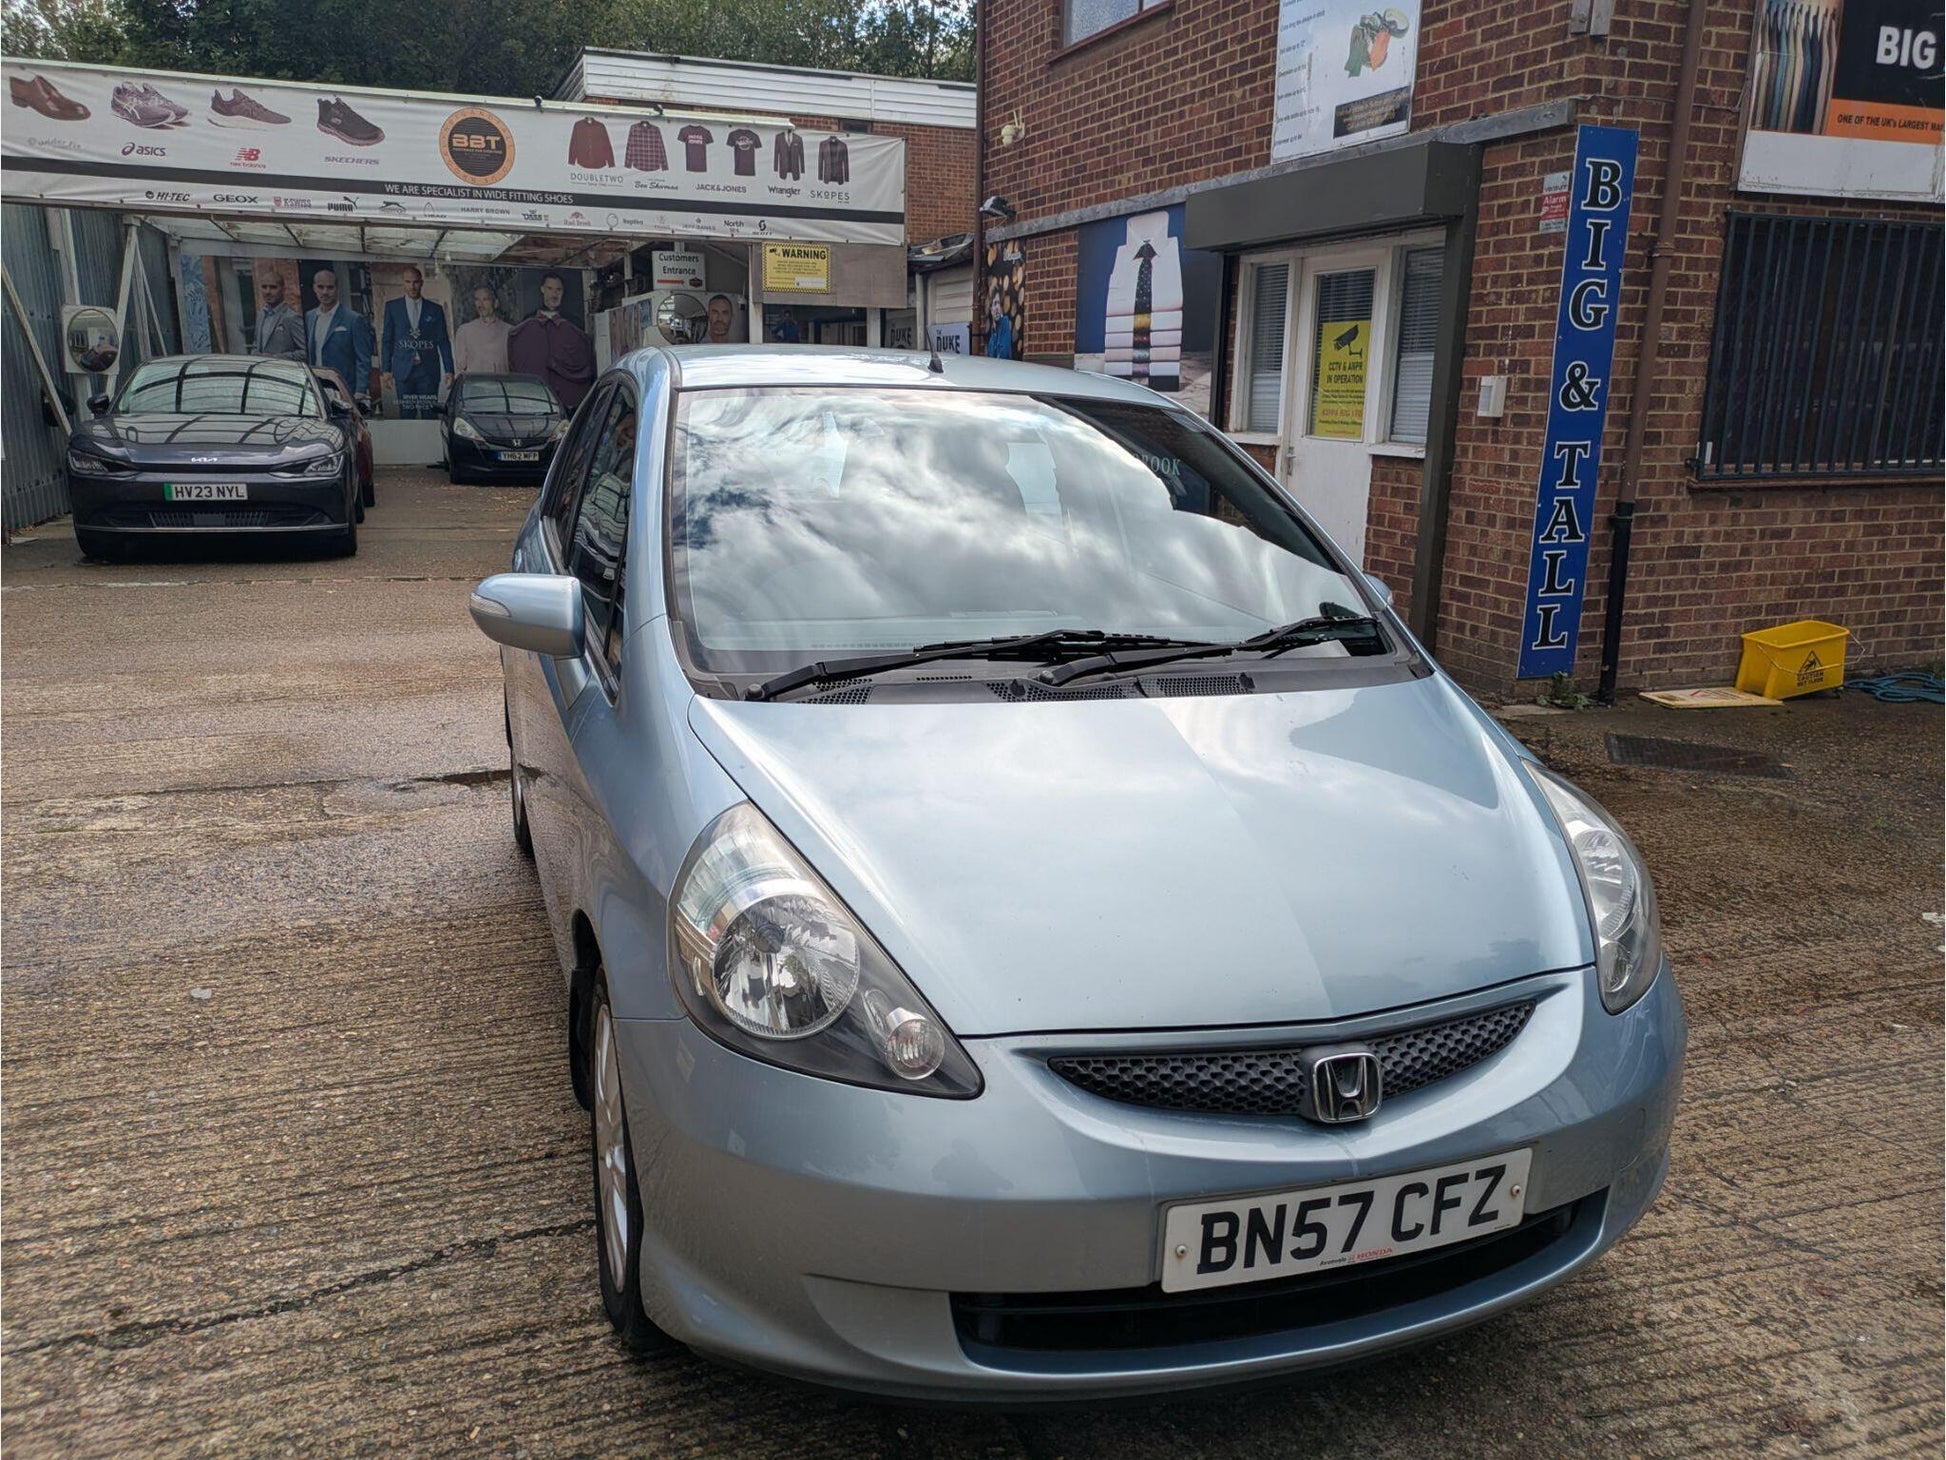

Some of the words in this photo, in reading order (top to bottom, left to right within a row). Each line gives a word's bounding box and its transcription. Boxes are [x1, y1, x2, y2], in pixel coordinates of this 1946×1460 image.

[1876, 26, 1937, 70] BIG
[1837, 114, 1853, 124] ONE
[1854, 115, 1864, 125] OF
[1866, 116, 1880, 127] THE
[1898, 119, 1930, 131] LARGEST
[453, 133, 501, 150] BBT
[136, 145, 167, 157] asics
[324, 156, 380, 166] SKECHERS
[634, 181, 647, 189] Ben
[649, 182, 679, 190] Sherman
[696, 184, 747, 194] JACK&JONES
[156, 192, 191, 202] HI-TEC
[384, 184, 400, 194] WE
[402, 185, 420, 195] ARE
[421, 185, 470, 198] SPECIALIST
[473, 188, 483, 198] IN
[483, 188, 508, 200] WIDE
[509, 191, 543, 202] FITTING
[544, 193, 574, 204] SHOES
[768, 186, 801, 198] Wrangler
[810, 190, 850, 201] SKOPES
[213, 194, 258, 204] GEOX
[1543, 195, 1567, 205] Alarm
[461, 206, 484, 214] HARRY
[1569, 158, 1623, 332] BIG
[658, 252, 700, 263] Customers
[781, 248, 827, 260] WARNING
[662, 266, 697, 276] Entrance
[891, 328, 912, 347] DUKE
[400, 340, 434, 349] SKOPES
[936, 335, 960, 354] DUKE
[1328, 361, 1341, 371] CCTV
[1327, 374, 1333, 383] IN
[1333, 374, 1363, 384] OPERATION
[1560, 360, 1600, 411] &
[174, 484, 212, 499] HV23
[216, 484, 245, 498] NYL
[1532, 441, 1591, 650] TALL
[1197, 1190, 1375, 1275] BN57
[1391, 1163, 1507, 1243] CFZ
[1357, 1247, 1393, 1259] HONDA
